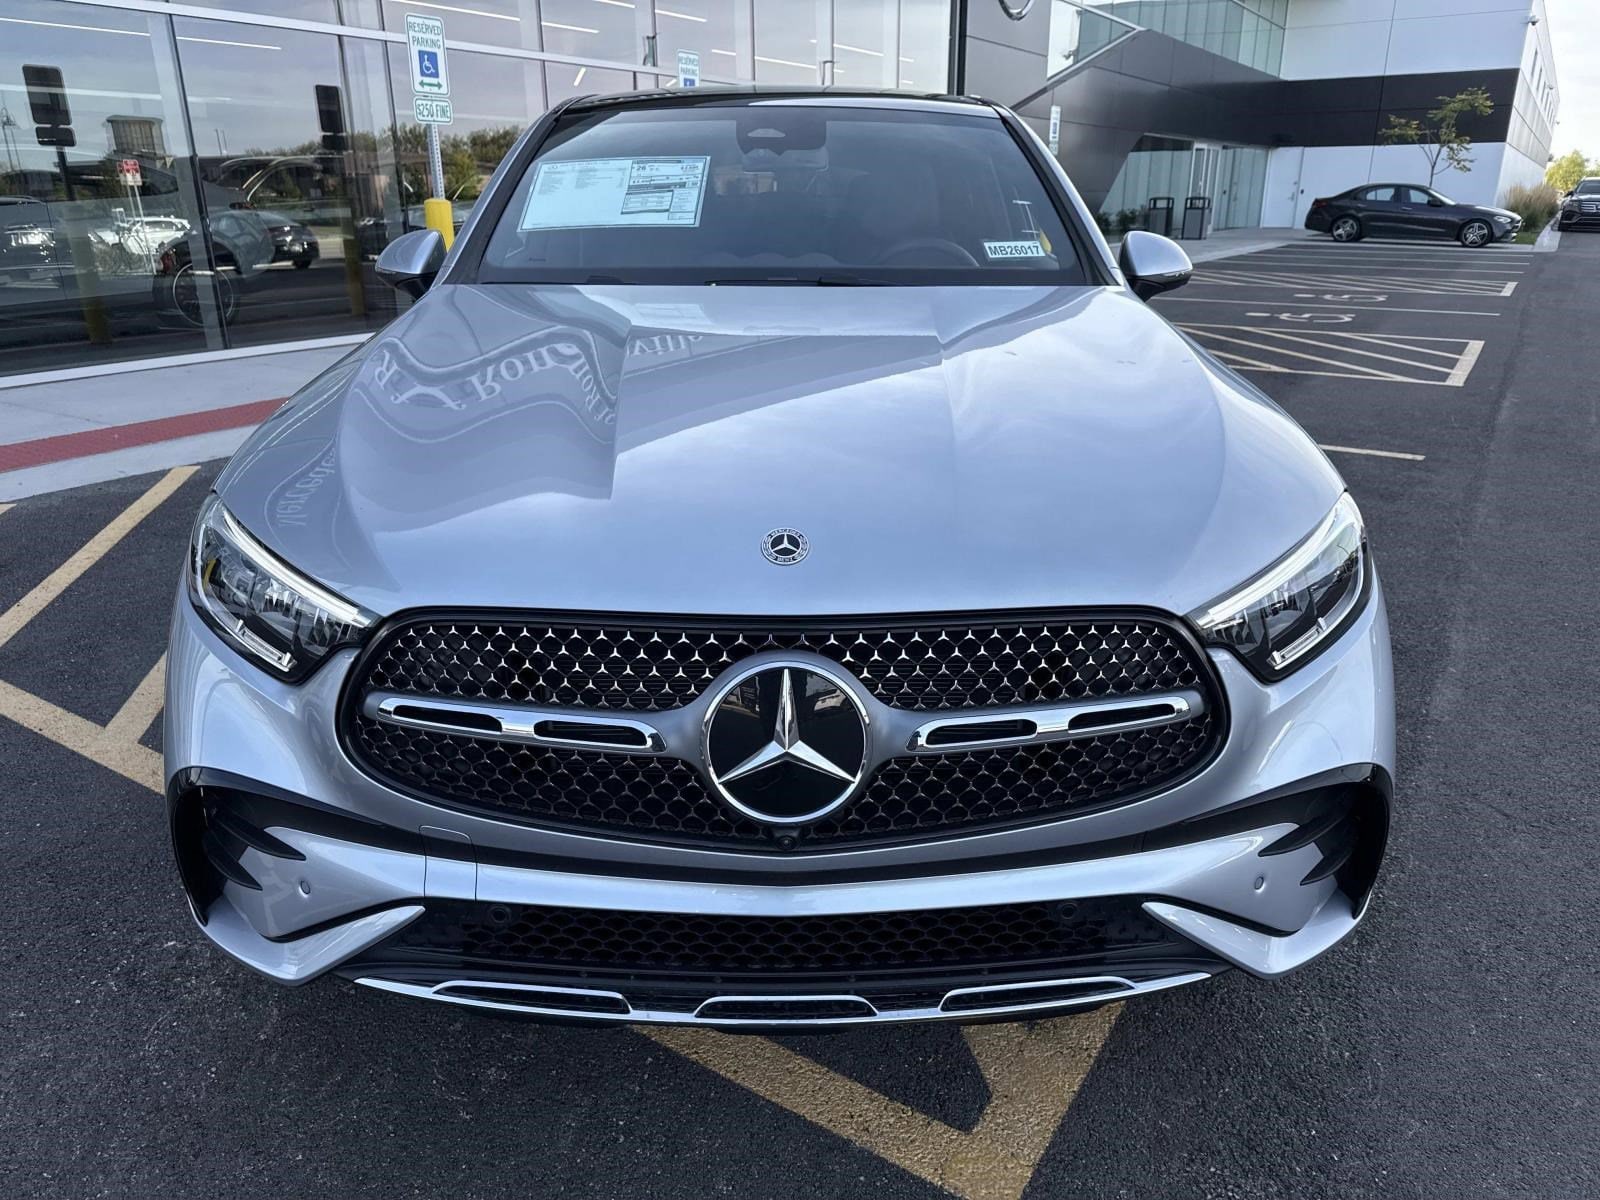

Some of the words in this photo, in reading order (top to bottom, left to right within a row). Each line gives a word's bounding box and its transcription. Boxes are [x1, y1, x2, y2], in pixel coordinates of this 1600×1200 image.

[408, 21, 441, 36] RESERVED
[412, 36, 441, 49] PARKING
[416, 103, 434, 118] $250
[435, 104, 450, 119] FINE
[988, 245, 1040, 256] MB26017
